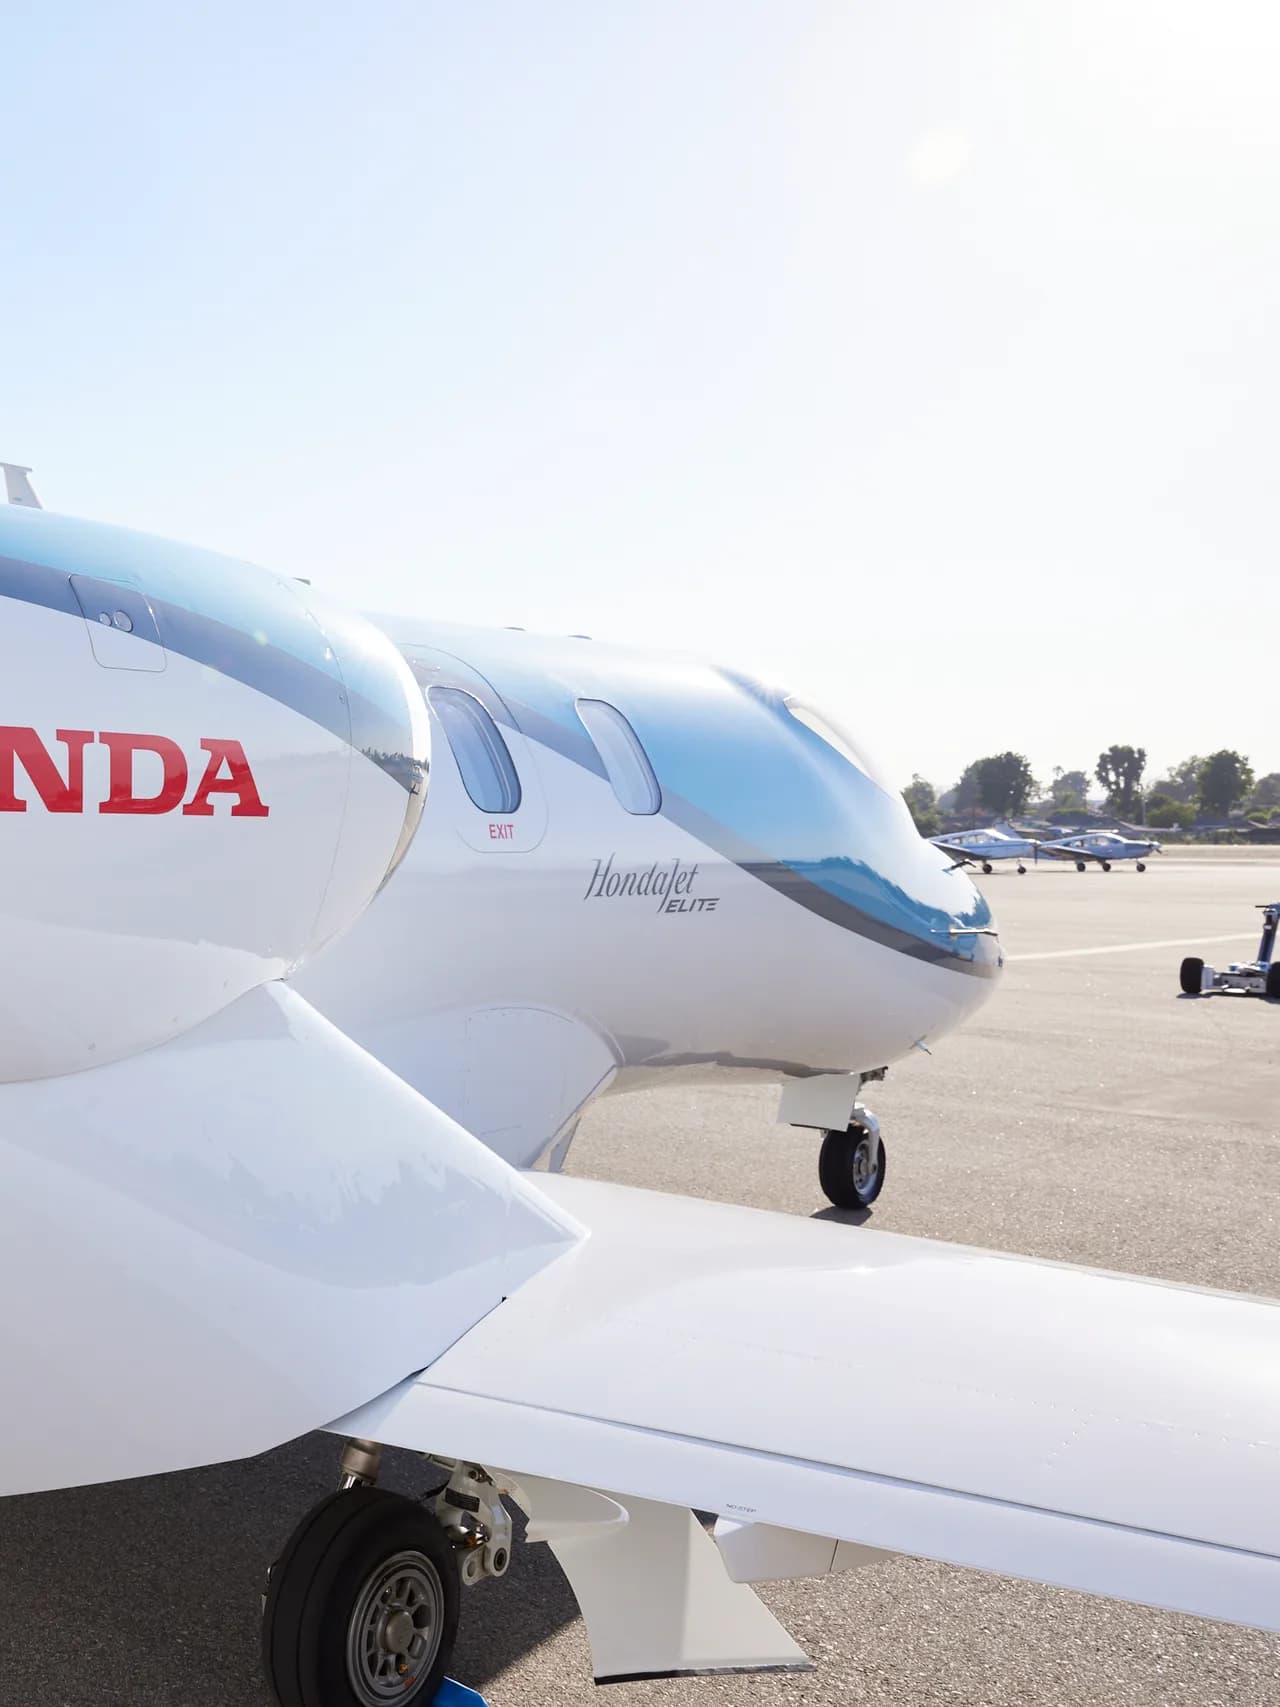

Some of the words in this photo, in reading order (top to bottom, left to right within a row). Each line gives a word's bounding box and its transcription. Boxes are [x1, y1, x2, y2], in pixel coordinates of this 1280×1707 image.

[489, 823, 514, 840] EXIT
[584, 852, 699, 913] HondaJet
[665, 897, 720, 914] ELITE
